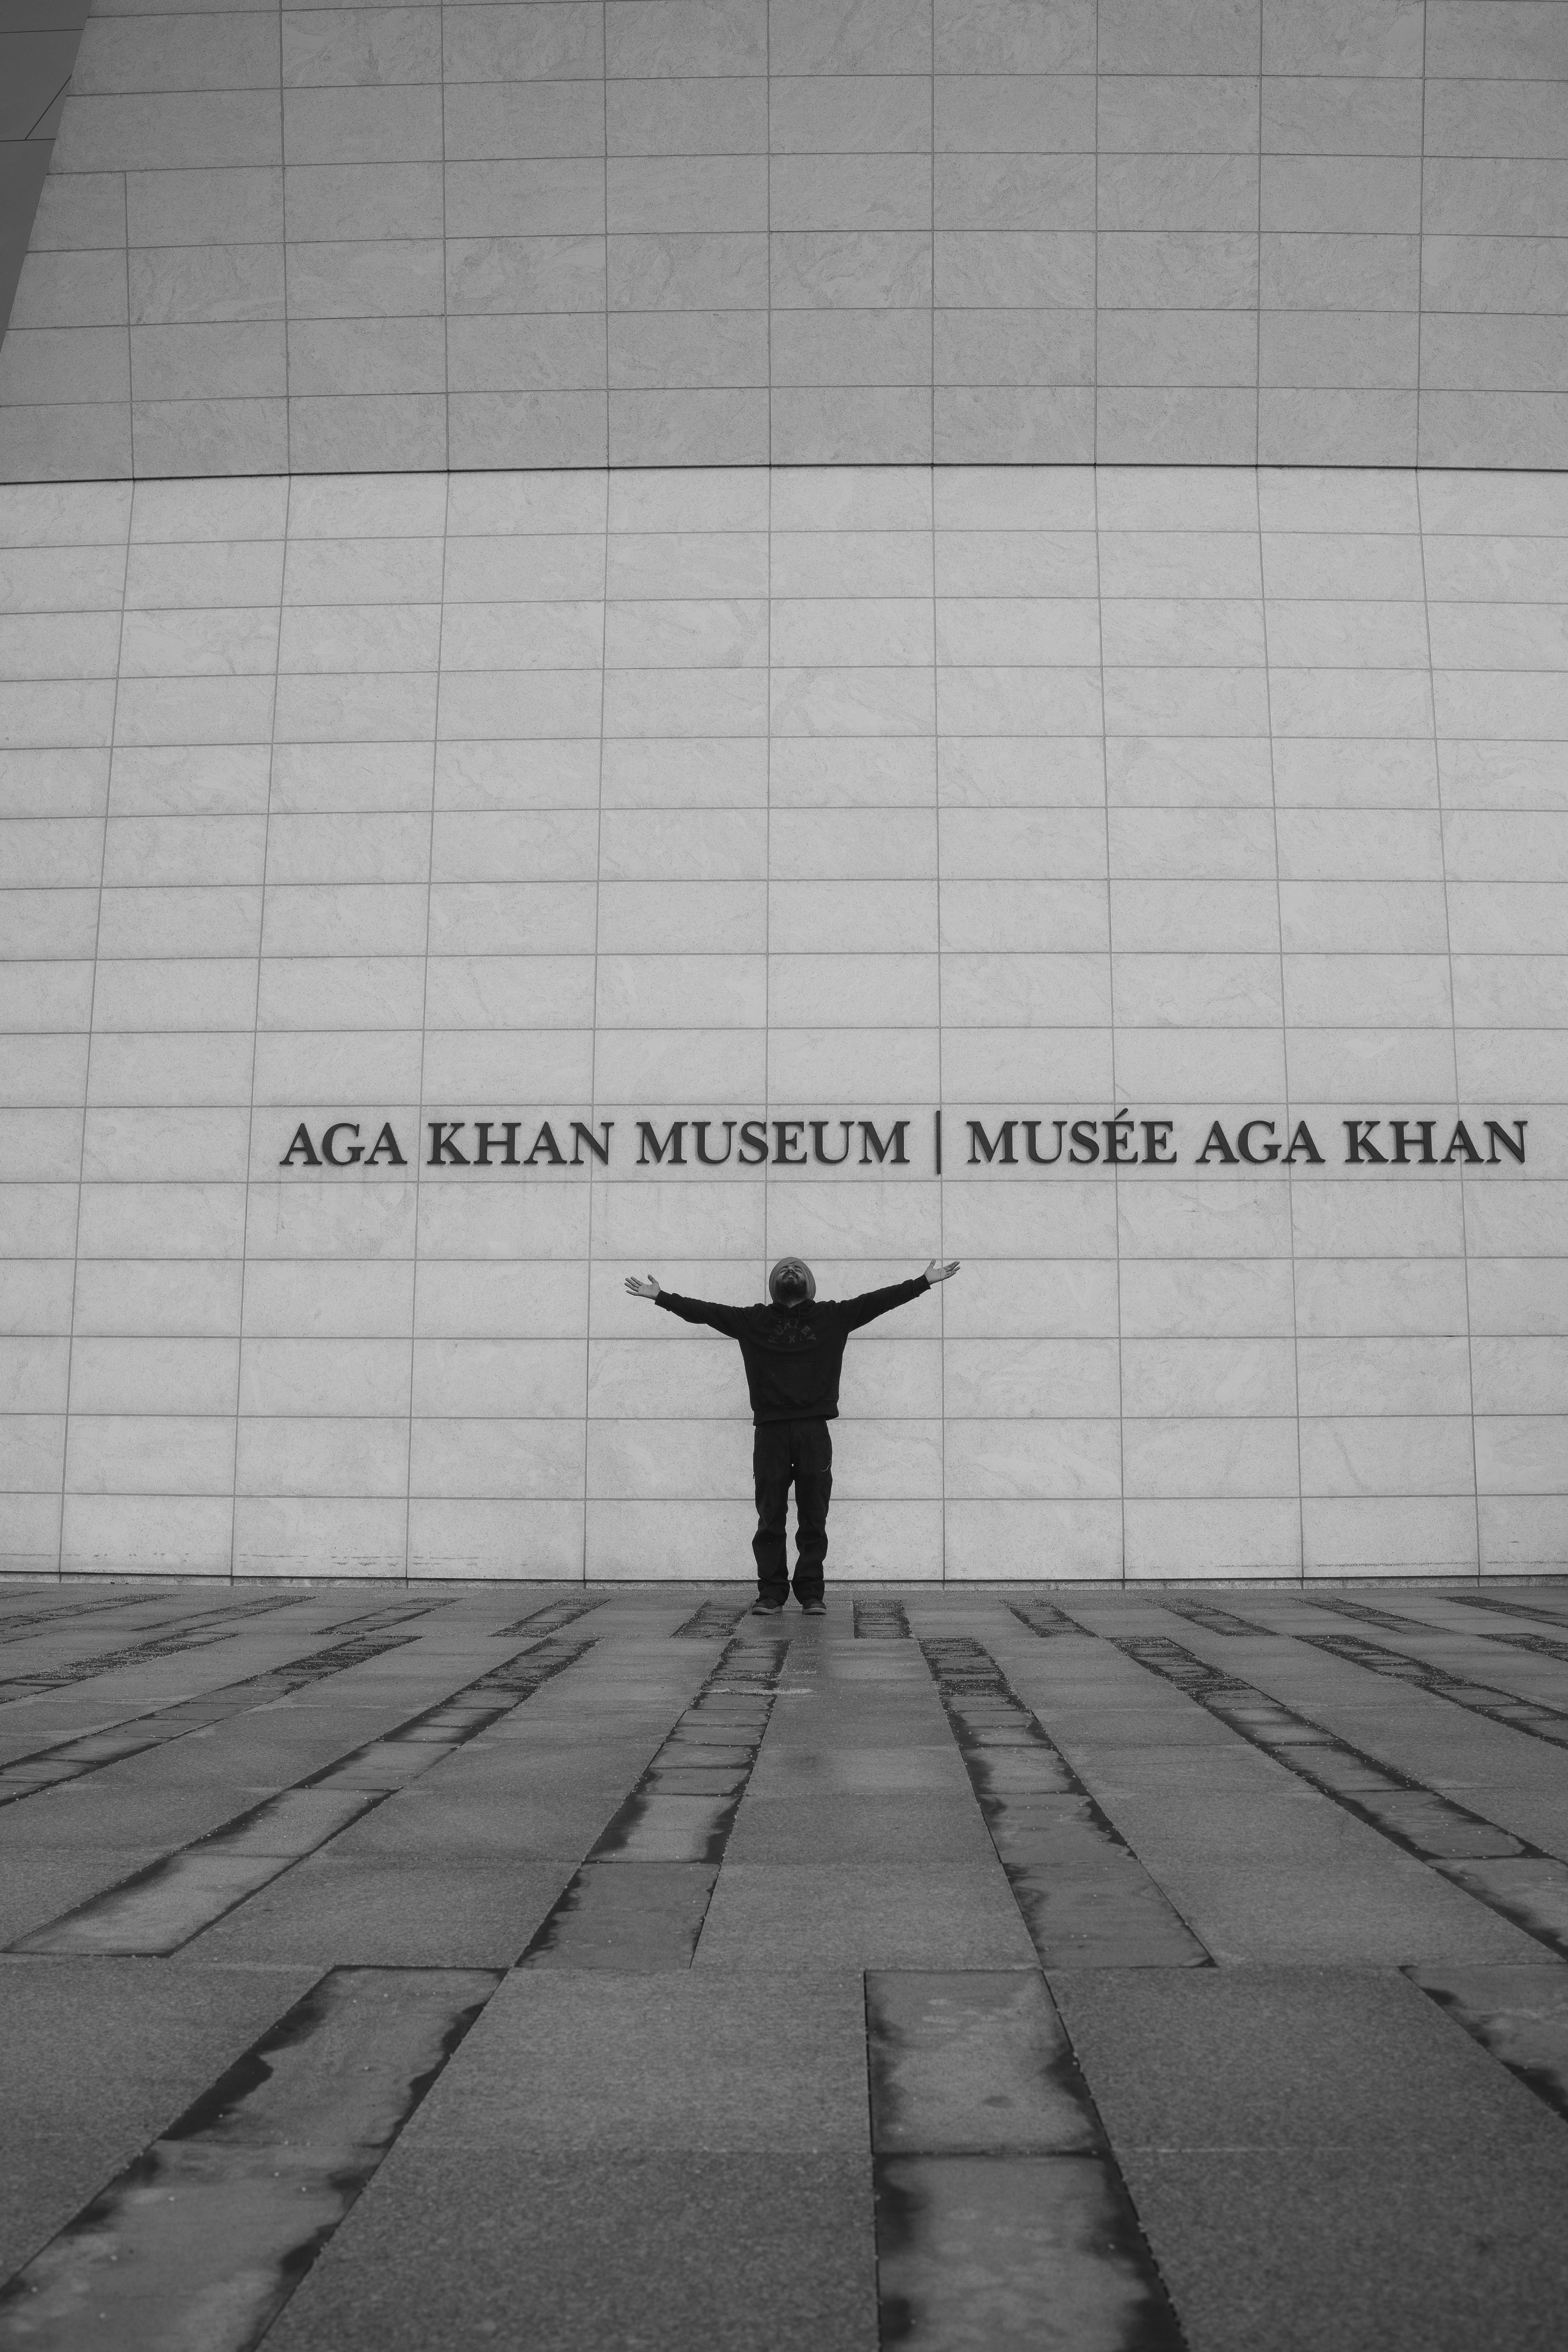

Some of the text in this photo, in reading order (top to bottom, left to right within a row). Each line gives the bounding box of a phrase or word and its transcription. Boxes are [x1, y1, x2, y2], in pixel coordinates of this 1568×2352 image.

[279, 1108, 1528, 1167] AGA KHAN MUSEUM MUSÉE AGA KHAN
[768, 1319, 816, 1343] HURLEY
